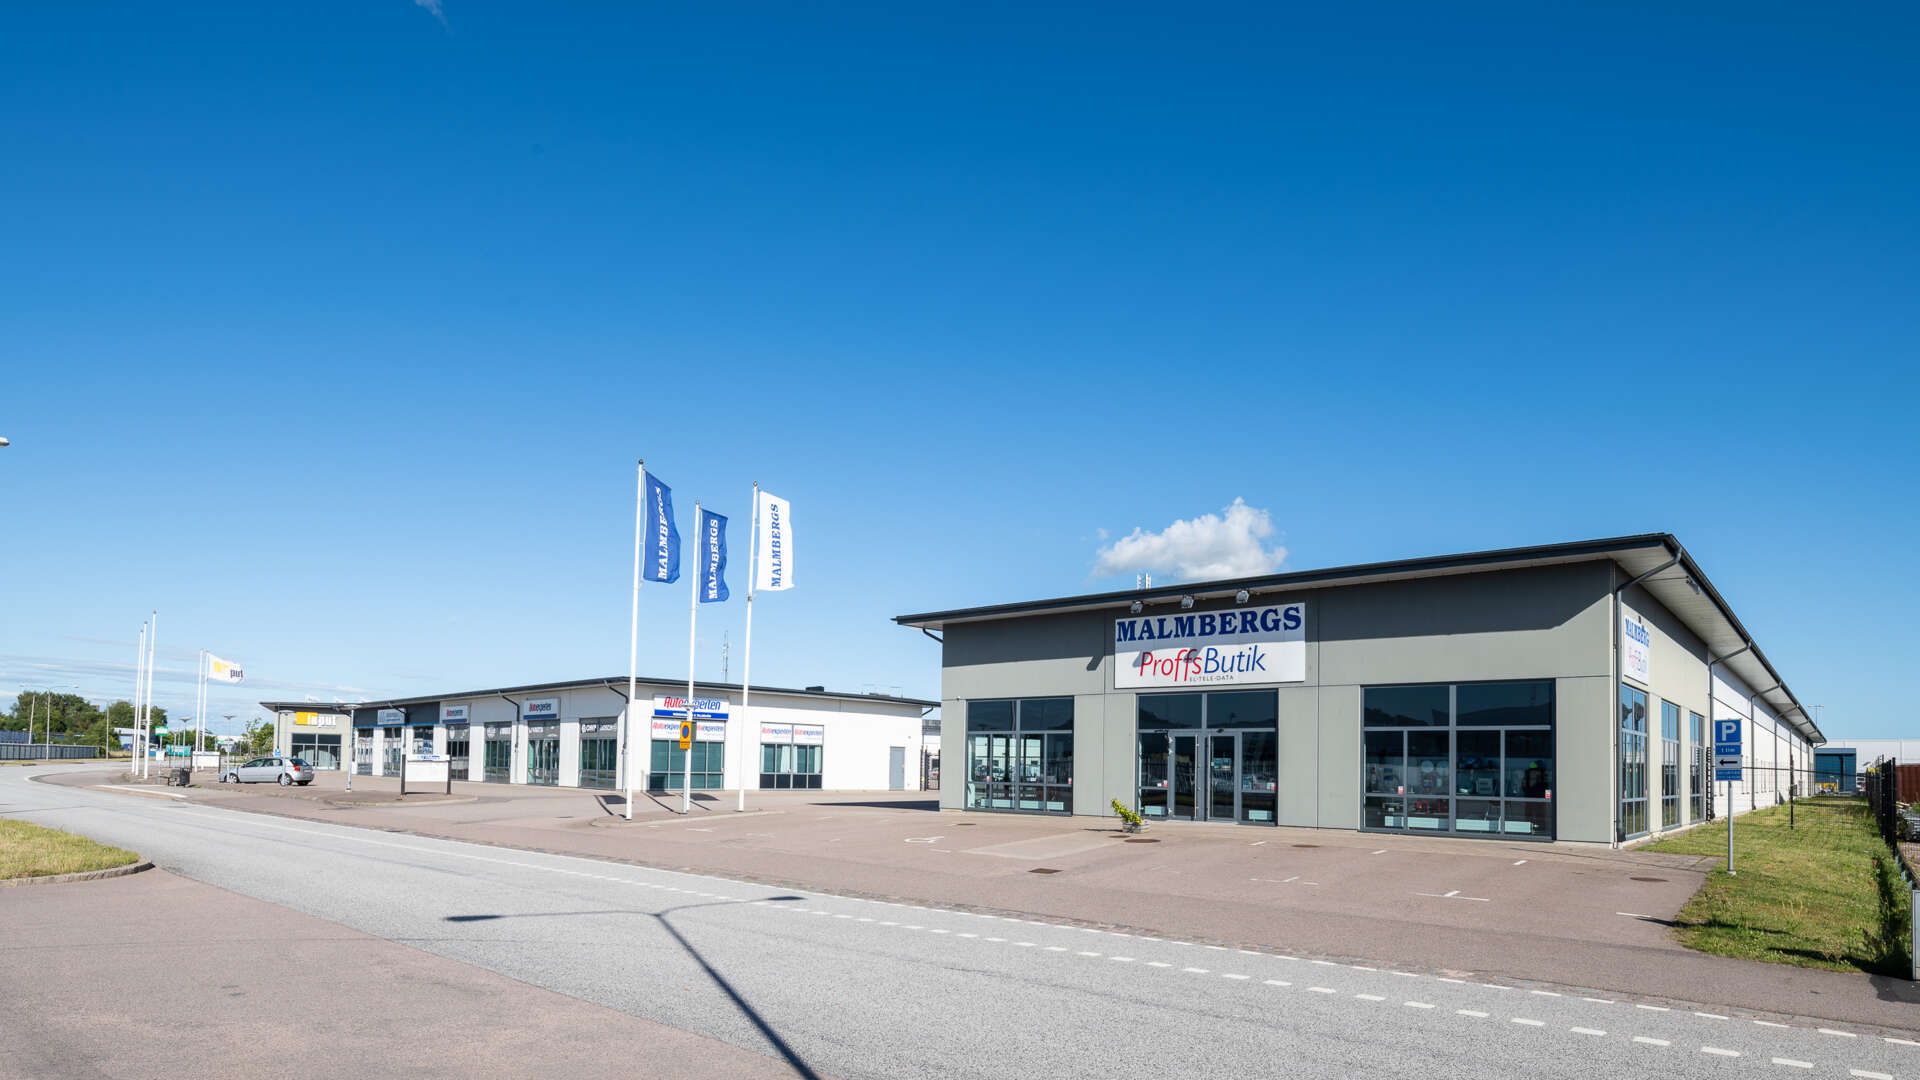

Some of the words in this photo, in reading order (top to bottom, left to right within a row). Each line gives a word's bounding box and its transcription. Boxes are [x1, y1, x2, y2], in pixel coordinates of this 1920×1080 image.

[708, 519, 720, 600] MALMBERGS
[770, 503, 782, 588] MALMBERGS
[1116, 606, 1302, 642] MALMBERGS
[1140, 645, 1266, 682] ProffsButik
[1721, 722, 1737, 741] P
